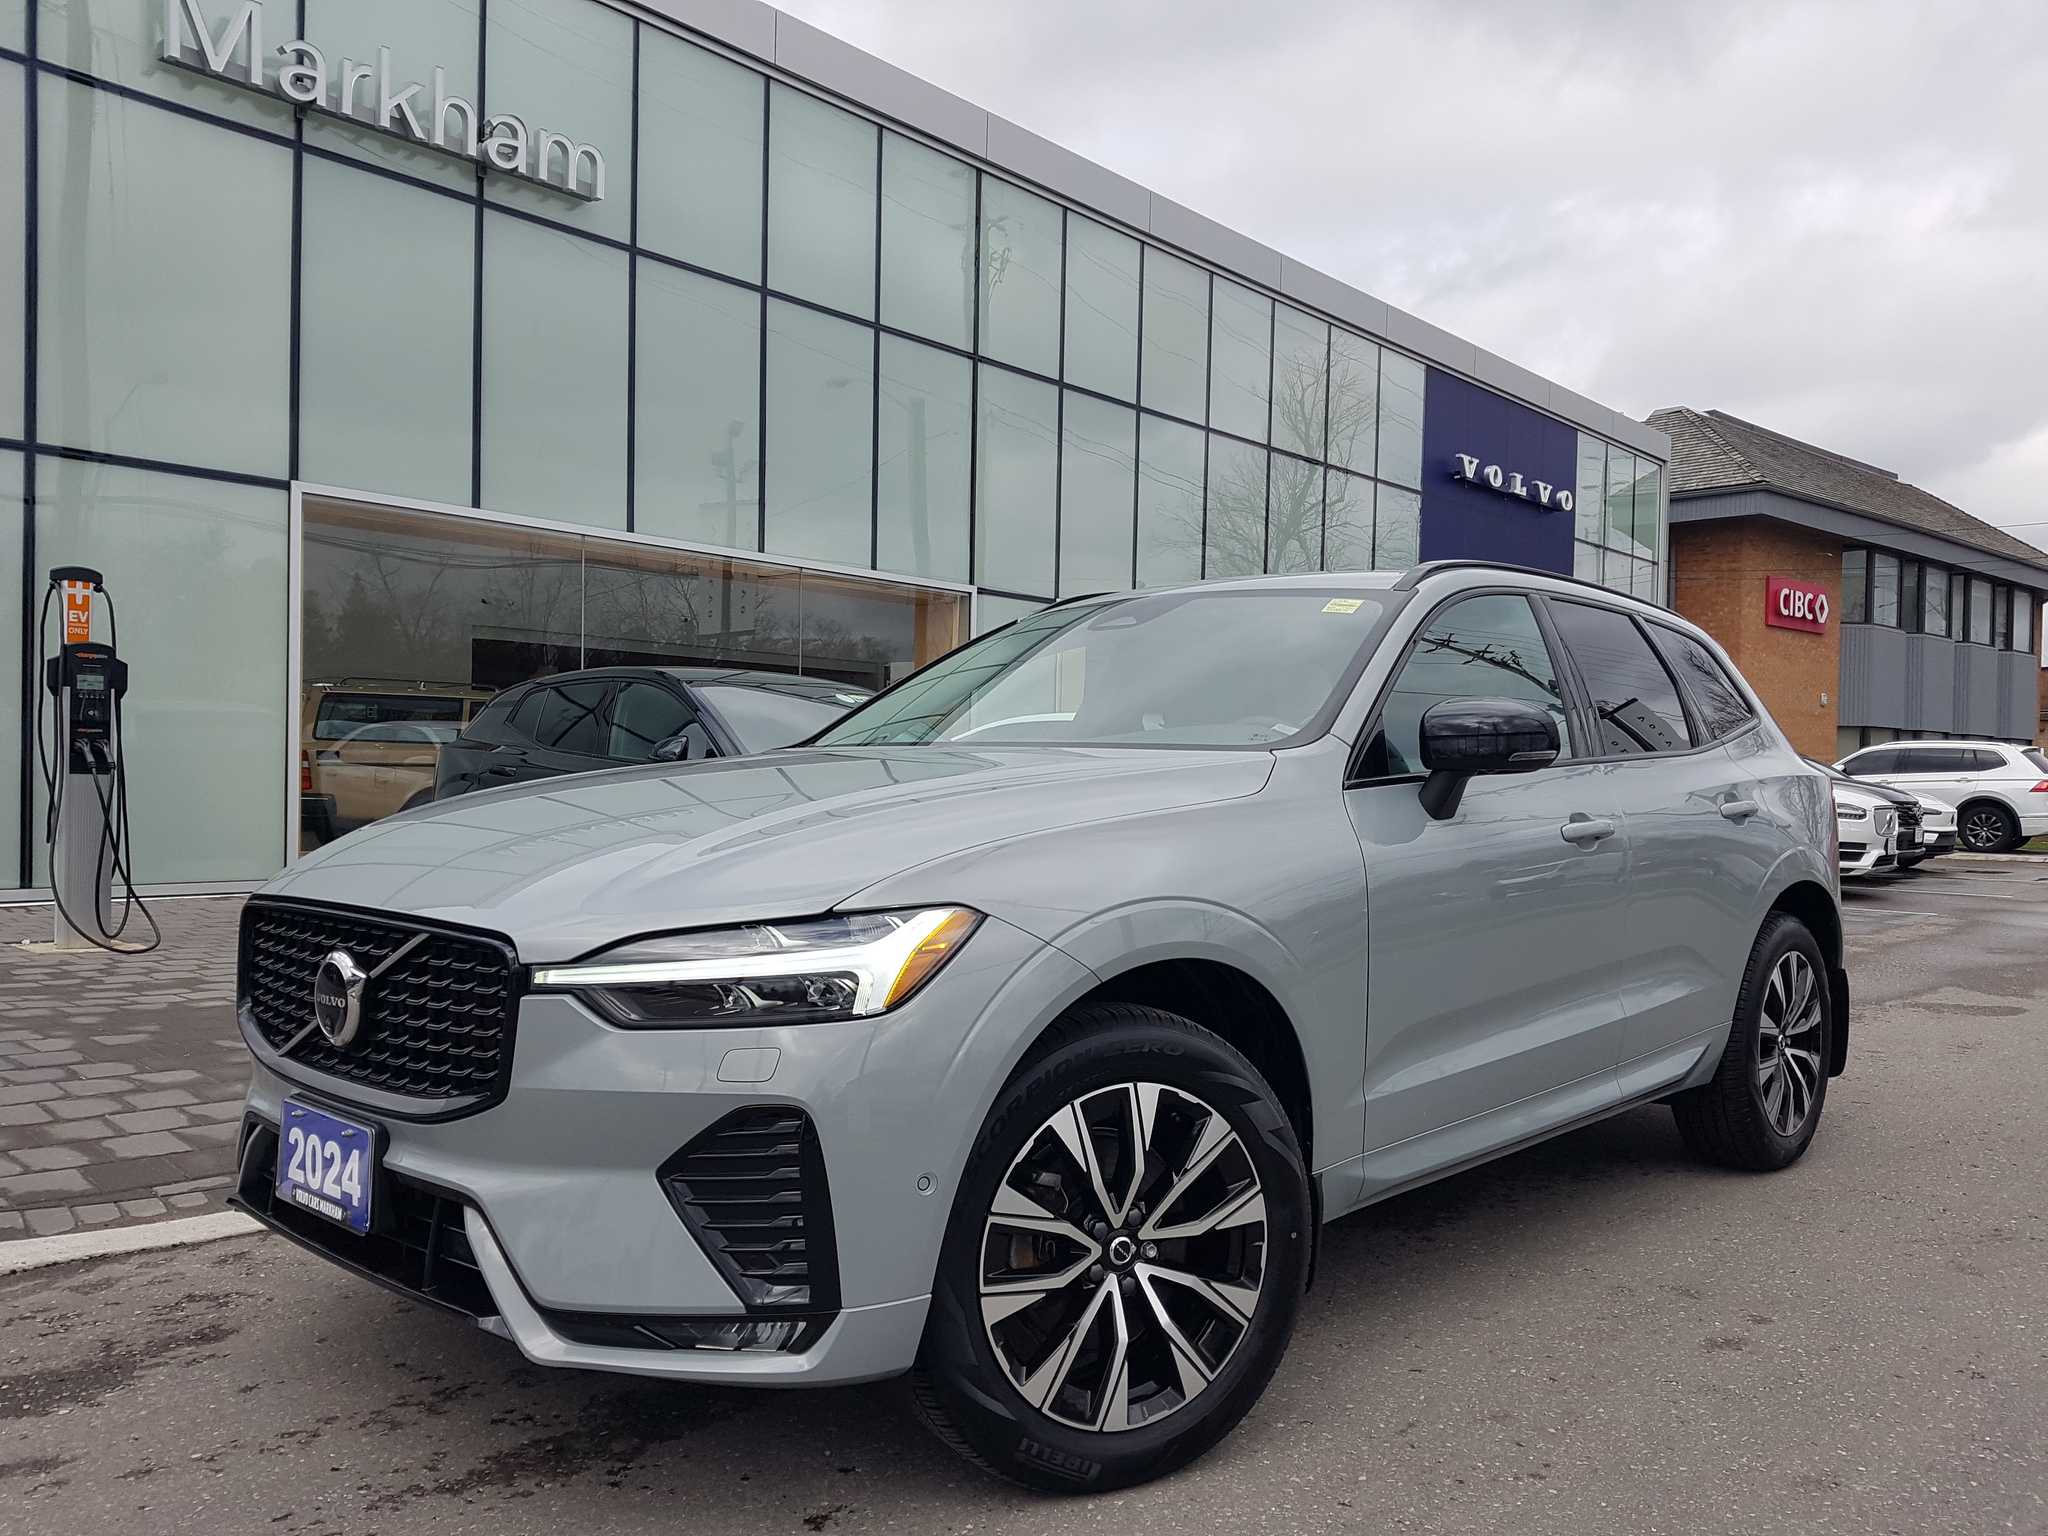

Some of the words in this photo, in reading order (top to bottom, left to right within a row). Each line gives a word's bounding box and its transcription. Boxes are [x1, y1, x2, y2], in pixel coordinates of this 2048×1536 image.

[163, 0, 605, 200] Markham
[1455, 453, 1573, 511] VOLVO
[68, 610, 89, 622] EV
[1780, 588, 1814, 620] CIBC
[68, 626, 89, 635] ONLY
[317, 993, 346, 1008] VOLVO
[287, 1126, 361, 1208] 2024
[308, 1194, 320, 1211] CARS
[319, 1198, 343, 1221] MARKHAM
[1015, 1438, 1102, 1483] PIRELLI
